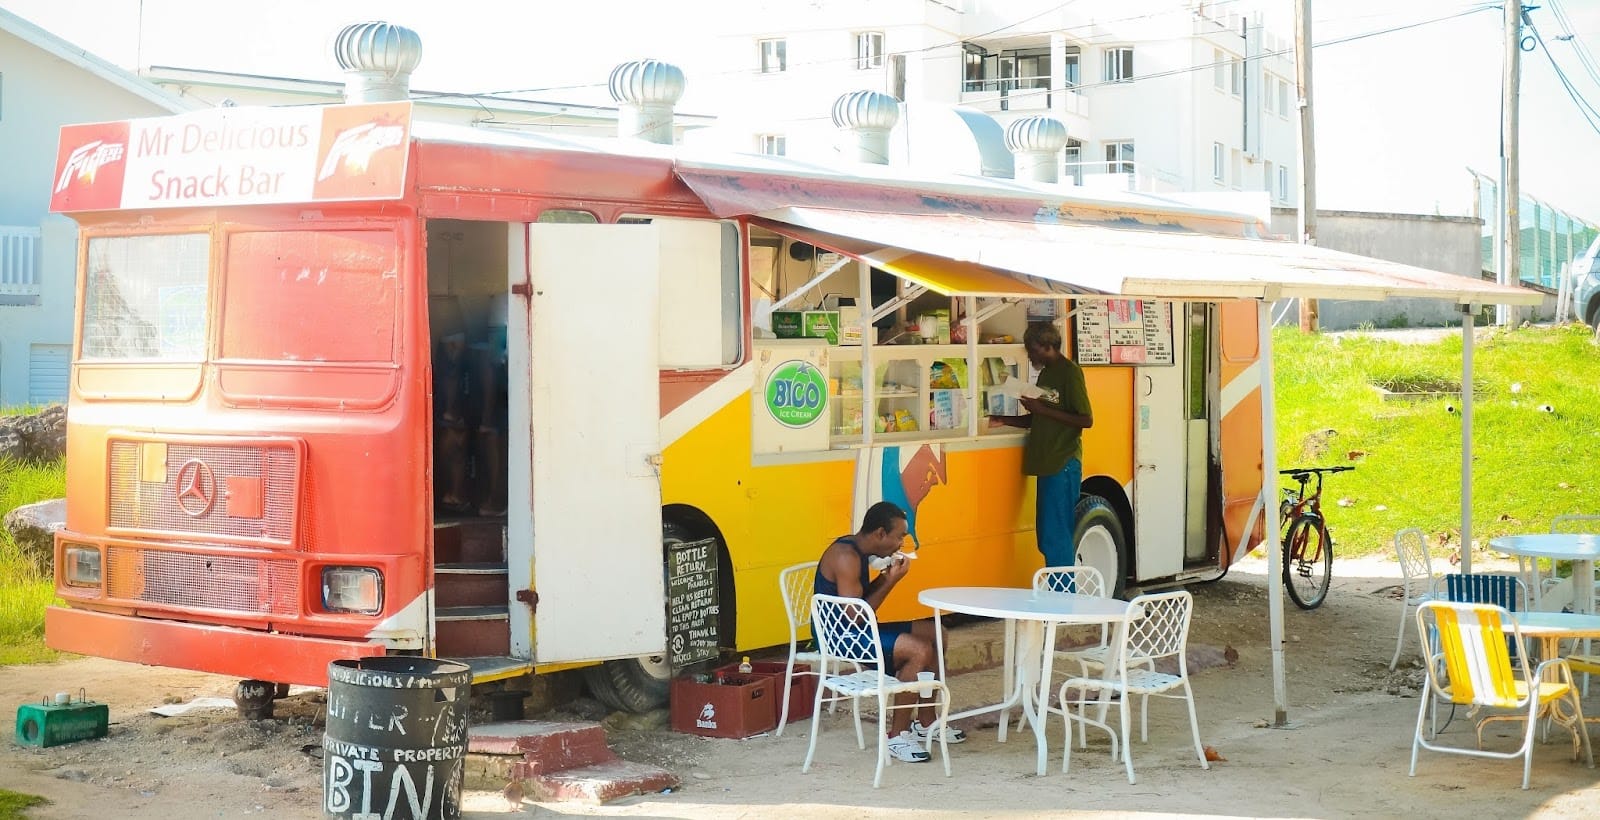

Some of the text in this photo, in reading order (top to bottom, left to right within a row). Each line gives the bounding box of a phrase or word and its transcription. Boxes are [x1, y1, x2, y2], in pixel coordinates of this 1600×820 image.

[138, 127, 172, 158] Mr
[181, 122, 310, 155] Delicious
[149, 165, 285, 200] Snack Bar
[773, 378, 820, 409] BICO
[676, 546, 708, 565] BOTTLE
[677, 561, 706, 577] RETURN
[325, 739, 464, 762] PRIVATE PROPERTY
[328, 755, 434, 820] BIN
